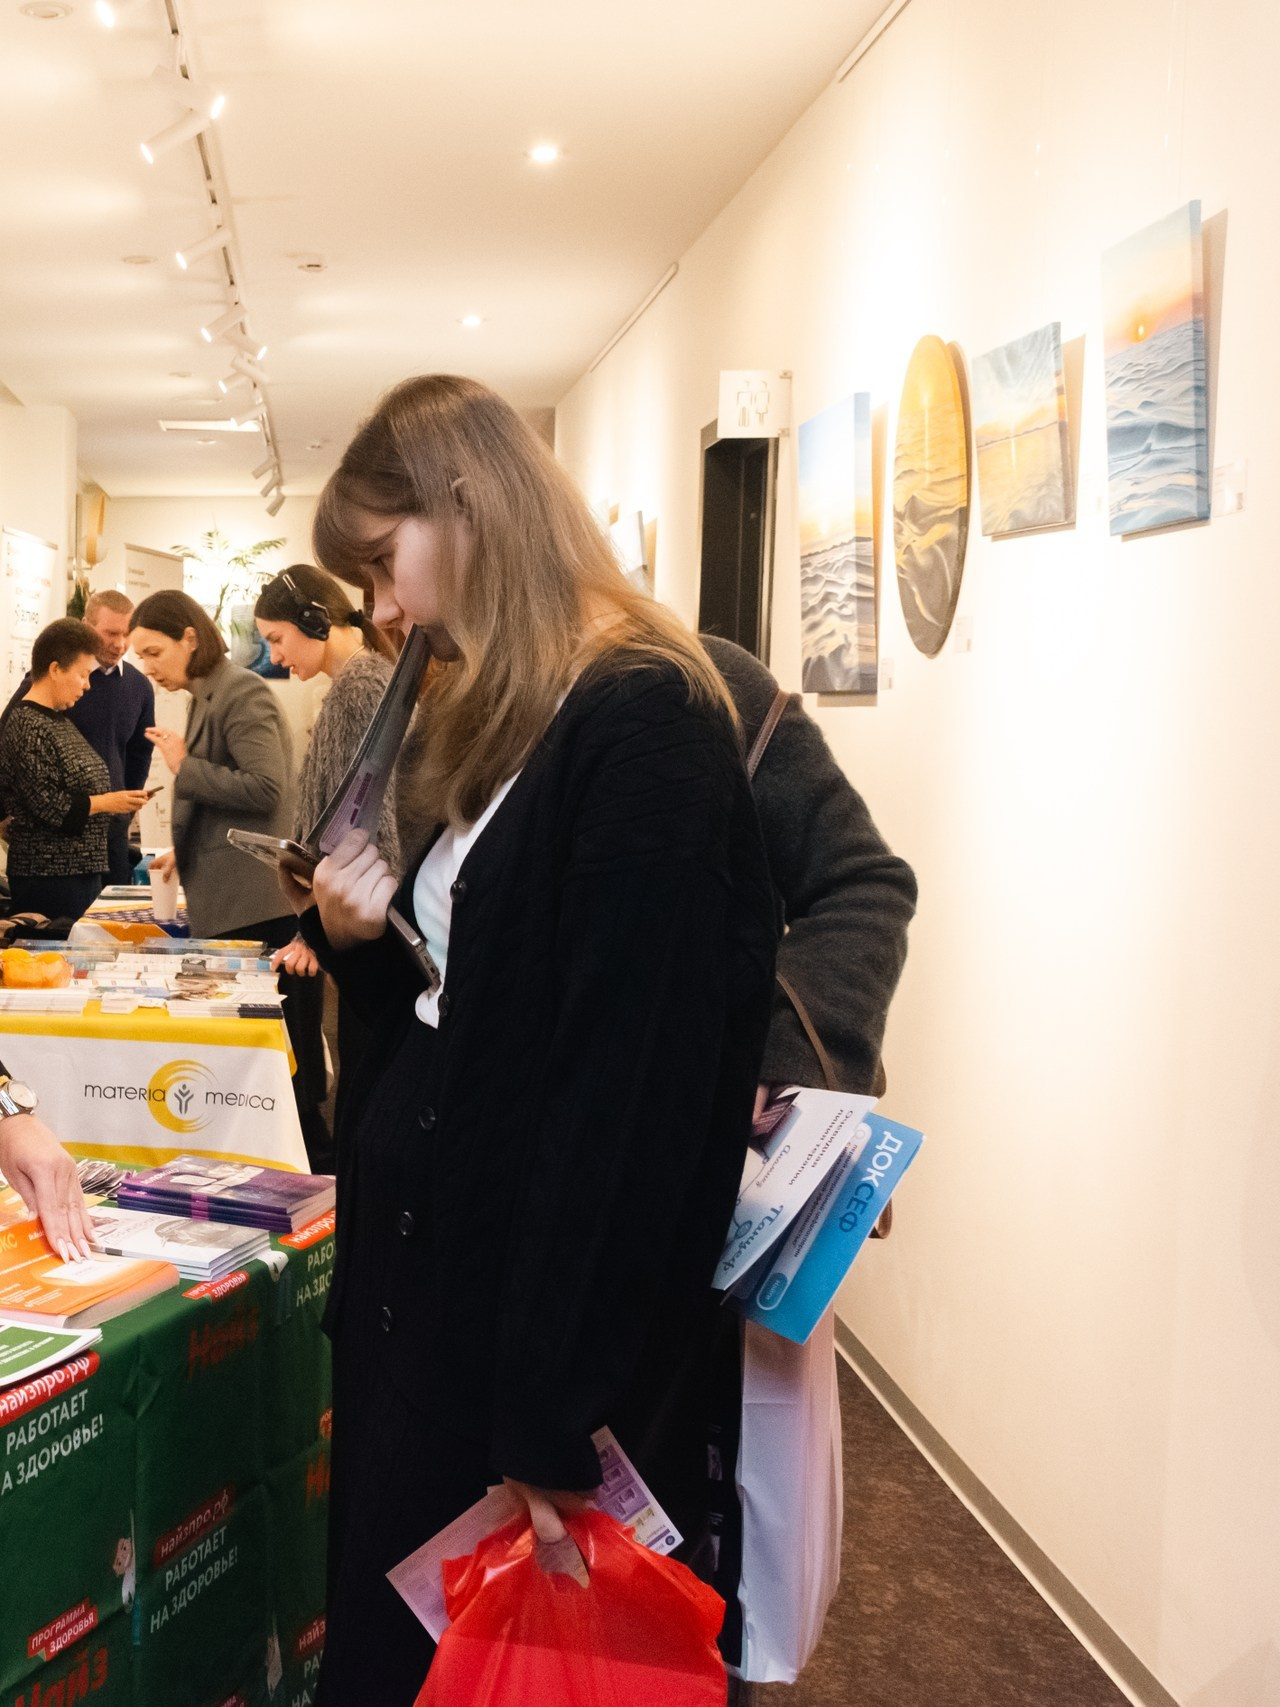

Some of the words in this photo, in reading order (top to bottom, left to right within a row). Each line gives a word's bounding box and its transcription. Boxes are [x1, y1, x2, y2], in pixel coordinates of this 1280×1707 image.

[839, 1130, 903, 1233] ДОКСЕФ
[307, 1241, 336, 1272] РАБО
[212, 1273, 247, 1299] ЗДОРОВЬЯ
[296, 1288, 312, 1307] НА
[312, 1269, 333, 1297] ЗДО
[6, 1388, 89, 1455] РАБОТАЕТ
[16, 1413, 104, 1485] ЗДОРОВЬЕ!
[160, 1488, 229, 1558] найзпро.рф
[165, 1525, 227, 1591] РАБОТАЕТ
[150, 1608, 170, 1634] НА
[170, 1545, 239, 1619] ЗДОРОВЬЕ!
[31, 1602, 87, 1650] ПРОГРАММА
[49, 1612, 95, 1653] ЗДОРОВЬЯ
[298, 1616, 326, 1650] найз
